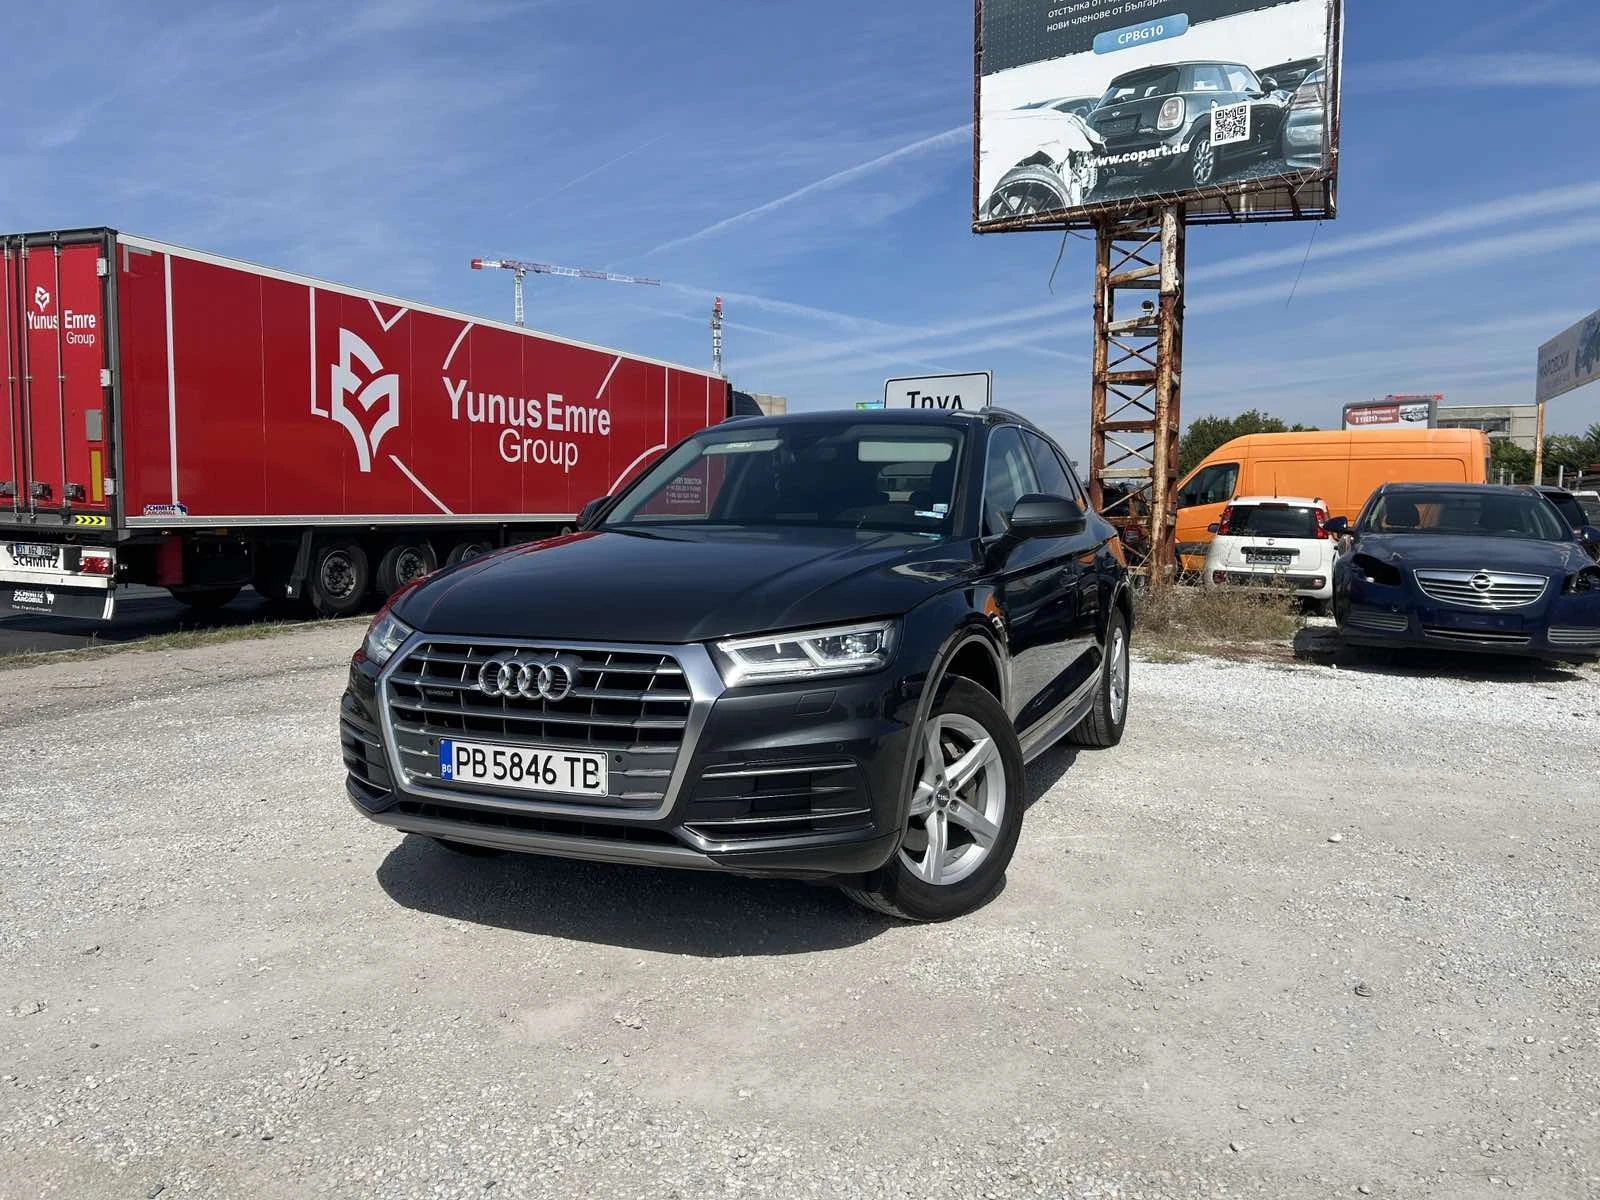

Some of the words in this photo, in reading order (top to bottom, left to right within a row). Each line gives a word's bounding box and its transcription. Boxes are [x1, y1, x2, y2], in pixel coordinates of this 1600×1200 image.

[1046, 20, 1070, 32] нови
[1071, 10, 1111, 25] членове
[1112, 6, 1123, 15] от
[1047, 1, 1090, 18] отстъпка
[1117, 25, 1164, 44] CPBG10
[1085, 143, 1190, 167] www.copart.de
[27, 311, 59, 330] Yunus
[64, 310, 96, 329] Emre
[66, 331, 95, 346] Group
[442, 377, 542, 428] Yunus
[546, 393, 611, 436] Emre
[498, 428, 578, 472] Group
[144, 503, 176, 511] SCHMITZ
[13, 556, 59, 569] SCHMITZ
[441, 764, 453, 774] BG
[456, 746, 488, 778] PB
[493, 751, 557, 786] 5846
[563, 756, 601, 790] TB
